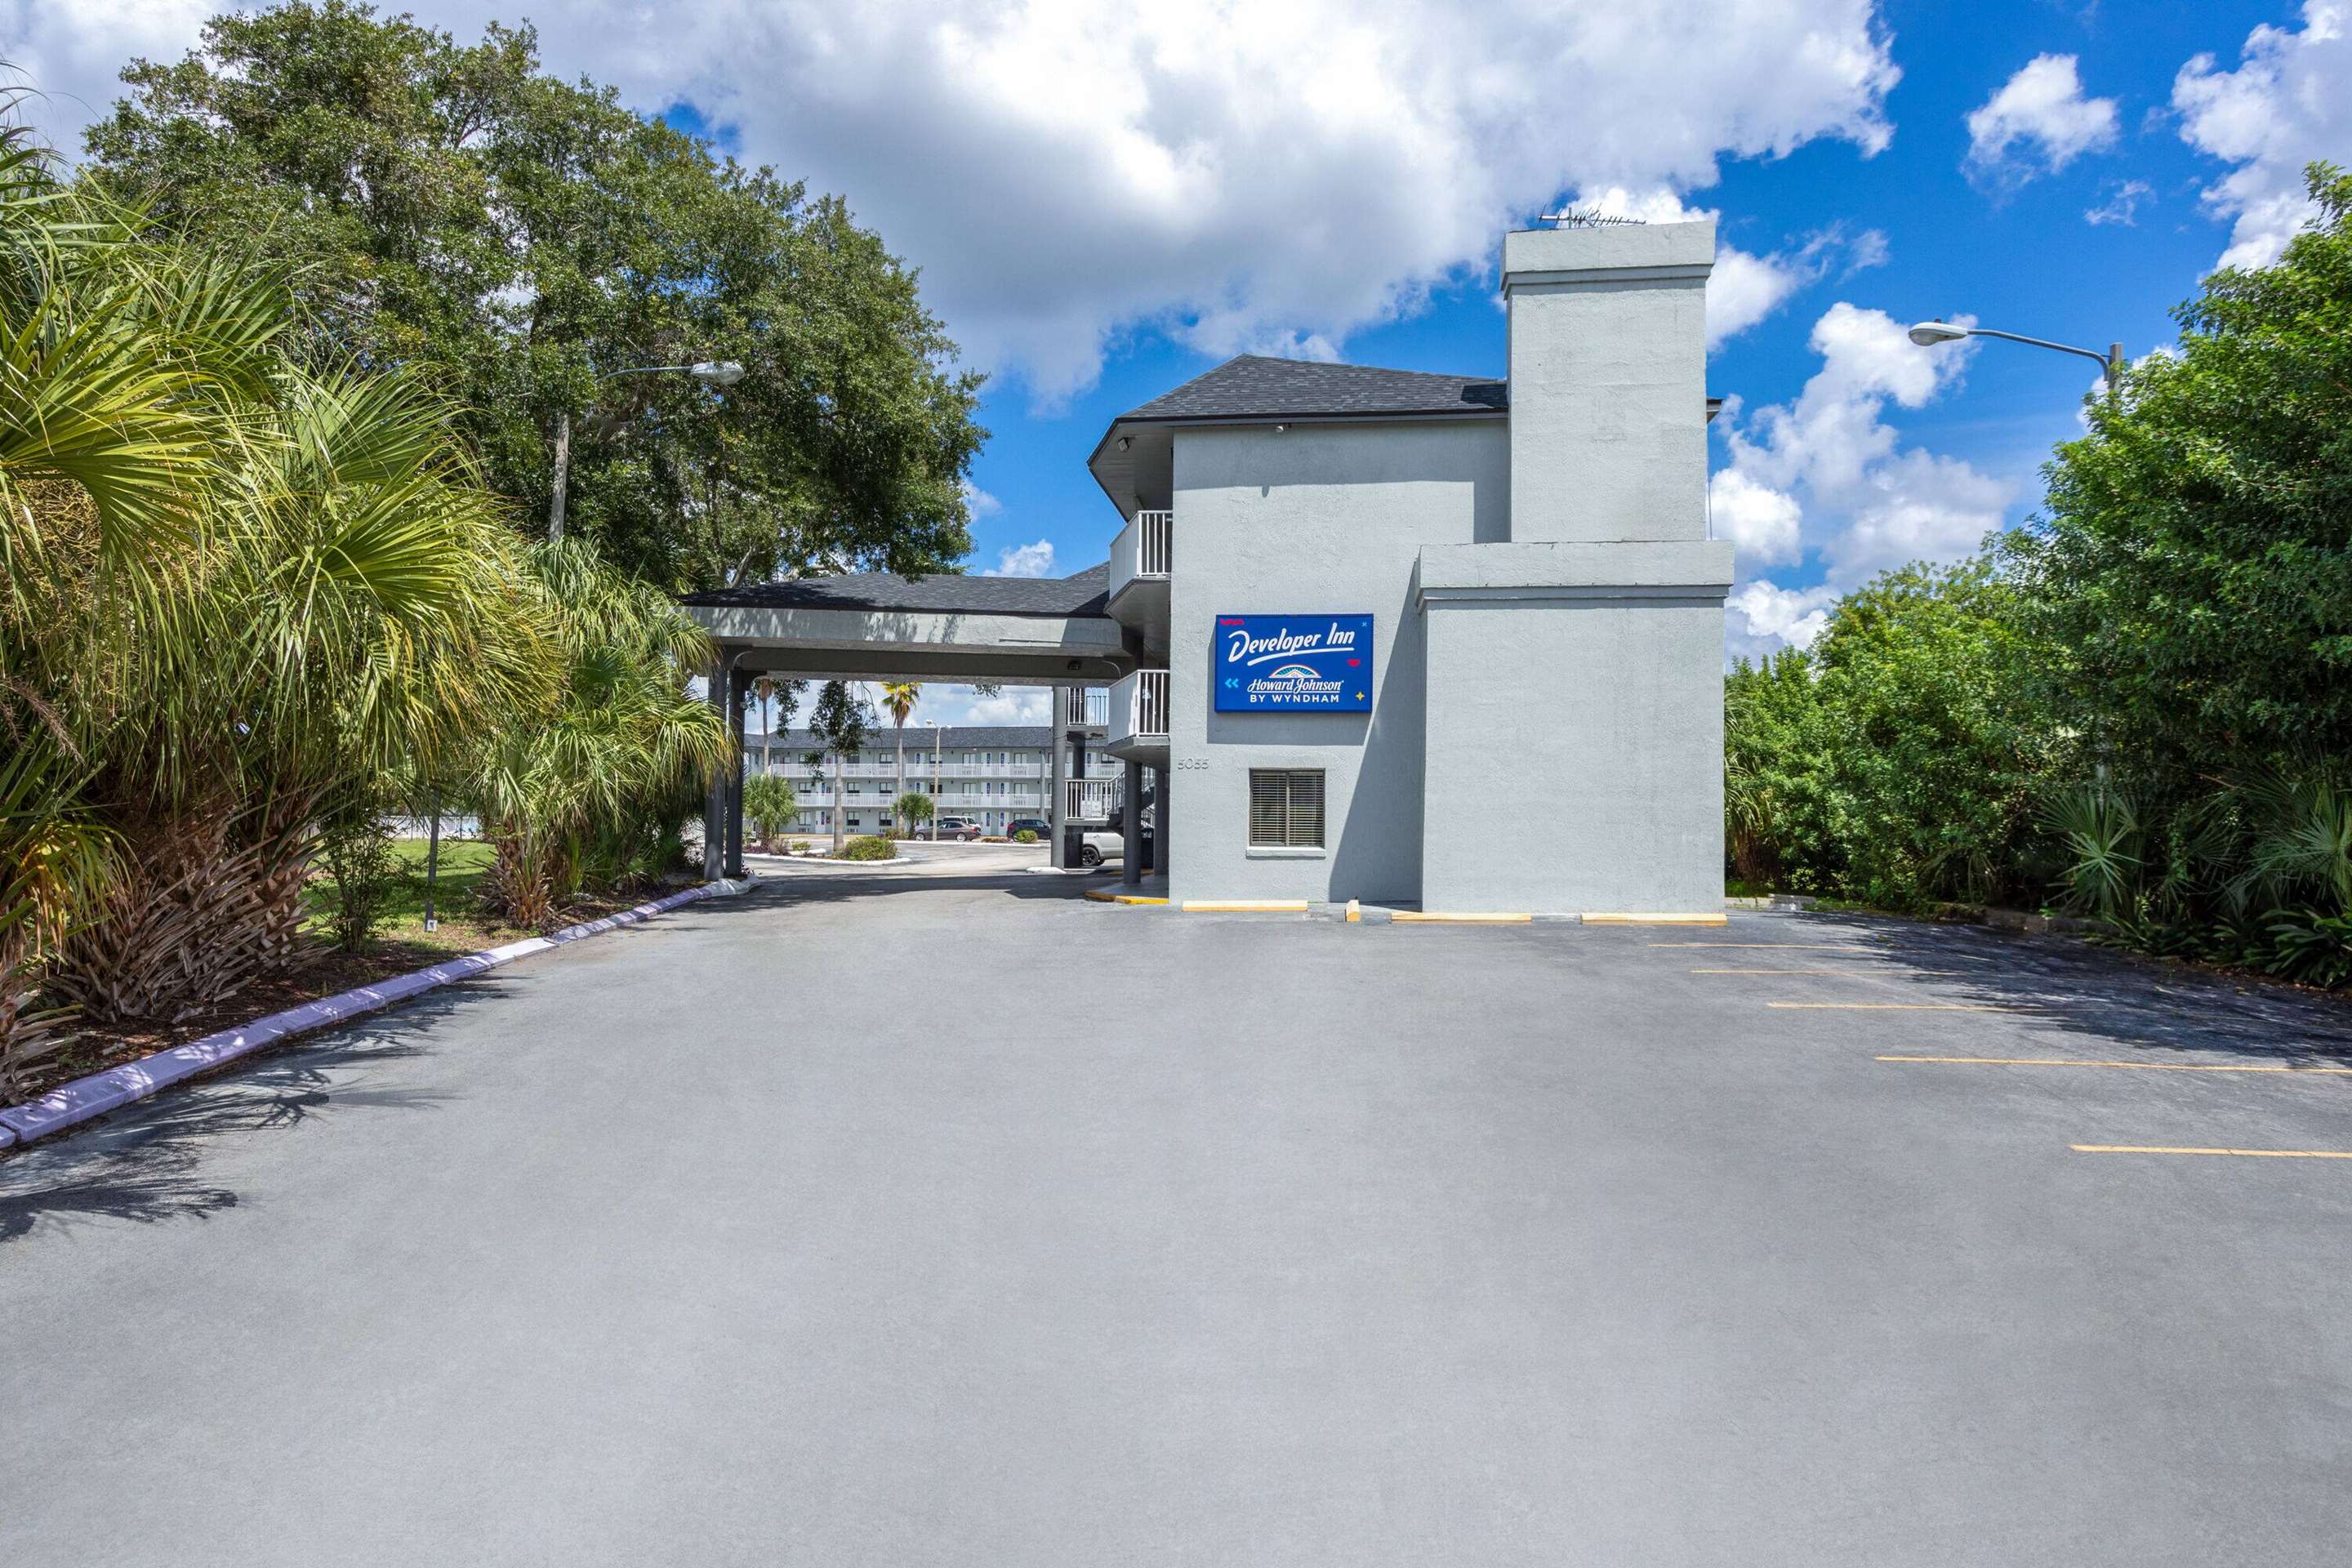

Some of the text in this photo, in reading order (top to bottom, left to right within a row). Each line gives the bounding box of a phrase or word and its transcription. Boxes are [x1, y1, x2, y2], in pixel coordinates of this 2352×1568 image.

[1228, 621, 1355, 662] Developer Inn
[1247, 678, 1342, 694] Howard Johnson
[1250, 694, 1339, 702] BY WYNDHAM
[1177, 758, 1209, 769] 5055
